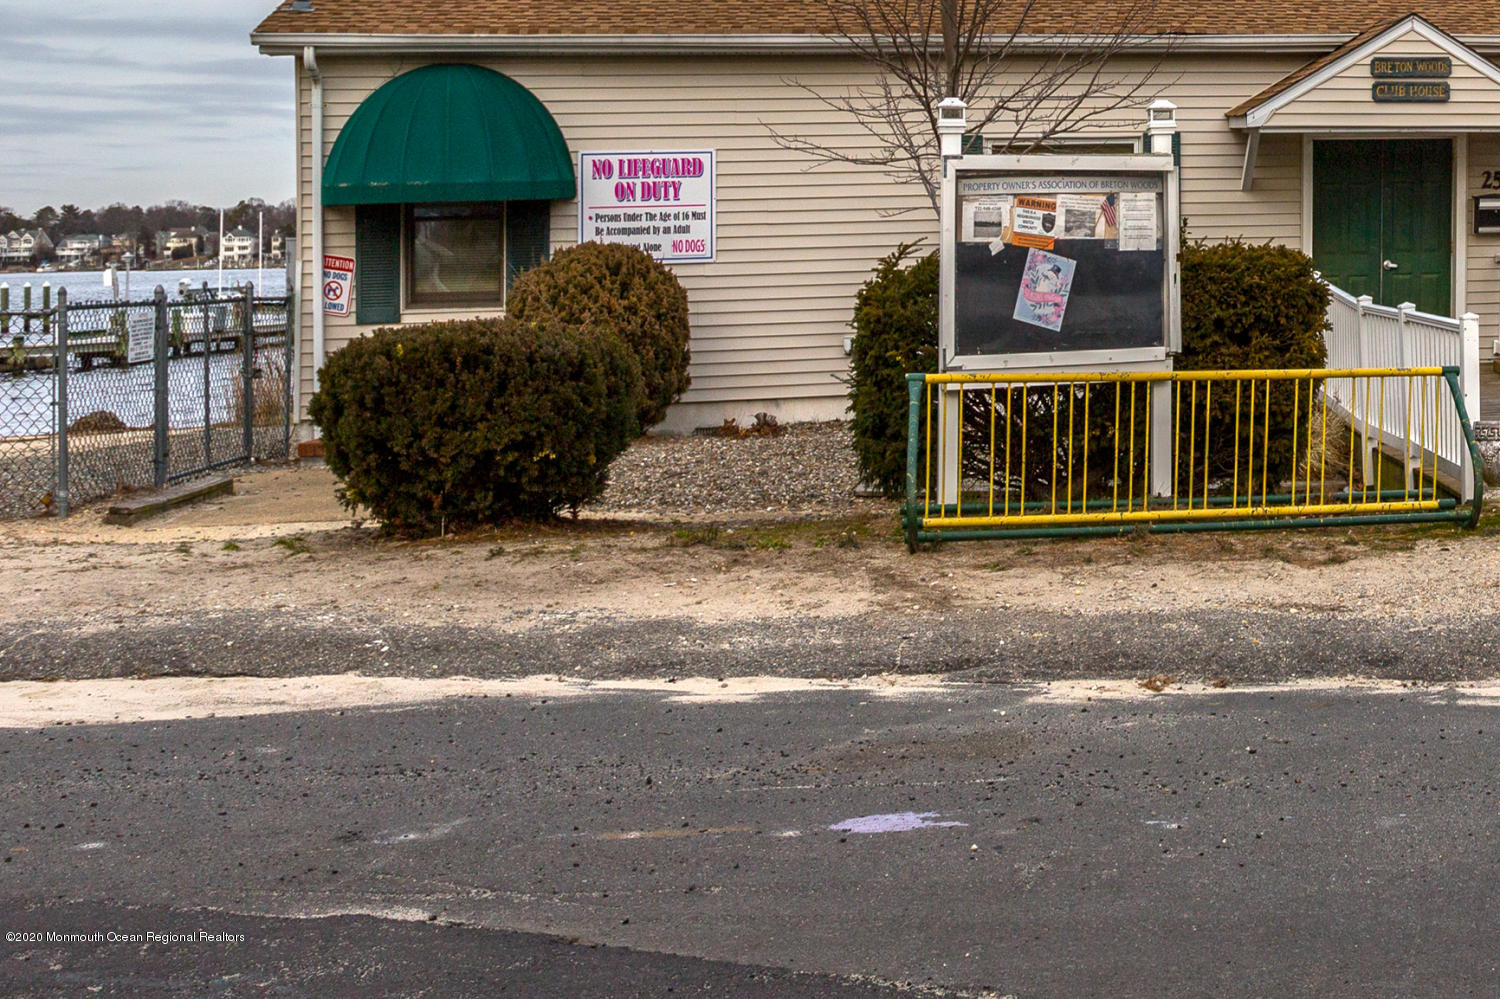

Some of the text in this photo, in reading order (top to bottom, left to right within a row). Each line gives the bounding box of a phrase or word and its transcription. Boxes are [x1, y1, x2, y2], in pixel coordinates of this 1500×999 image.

[1374, 61, 1449, 74] BRETON WOODS
[1376, 85, 1446, 97] CLUB HOUSE
[592, 157, 704, 179] NO LIFEGUARD
[615, 180, 682, 202] ON DUTY
[963, 180, 1158, 192] PROPERTY OWNER'S ASSOCIATION OF BRETON WOODS
[1018, 198, 1056, 210] WARNING
[595, 211, 706, 223] Persons Under The Age of 16 Must
[595, 224, 691, 237] Be Accompanied by an Adult
[643, 242, 662, 252] Alone
[672, 239, 683, 253] NO
[685, 239, 705, 253] DOGS
[325, 257, 353, 270] TTENTION
[323, 271, 348, 281] NO DOGS
